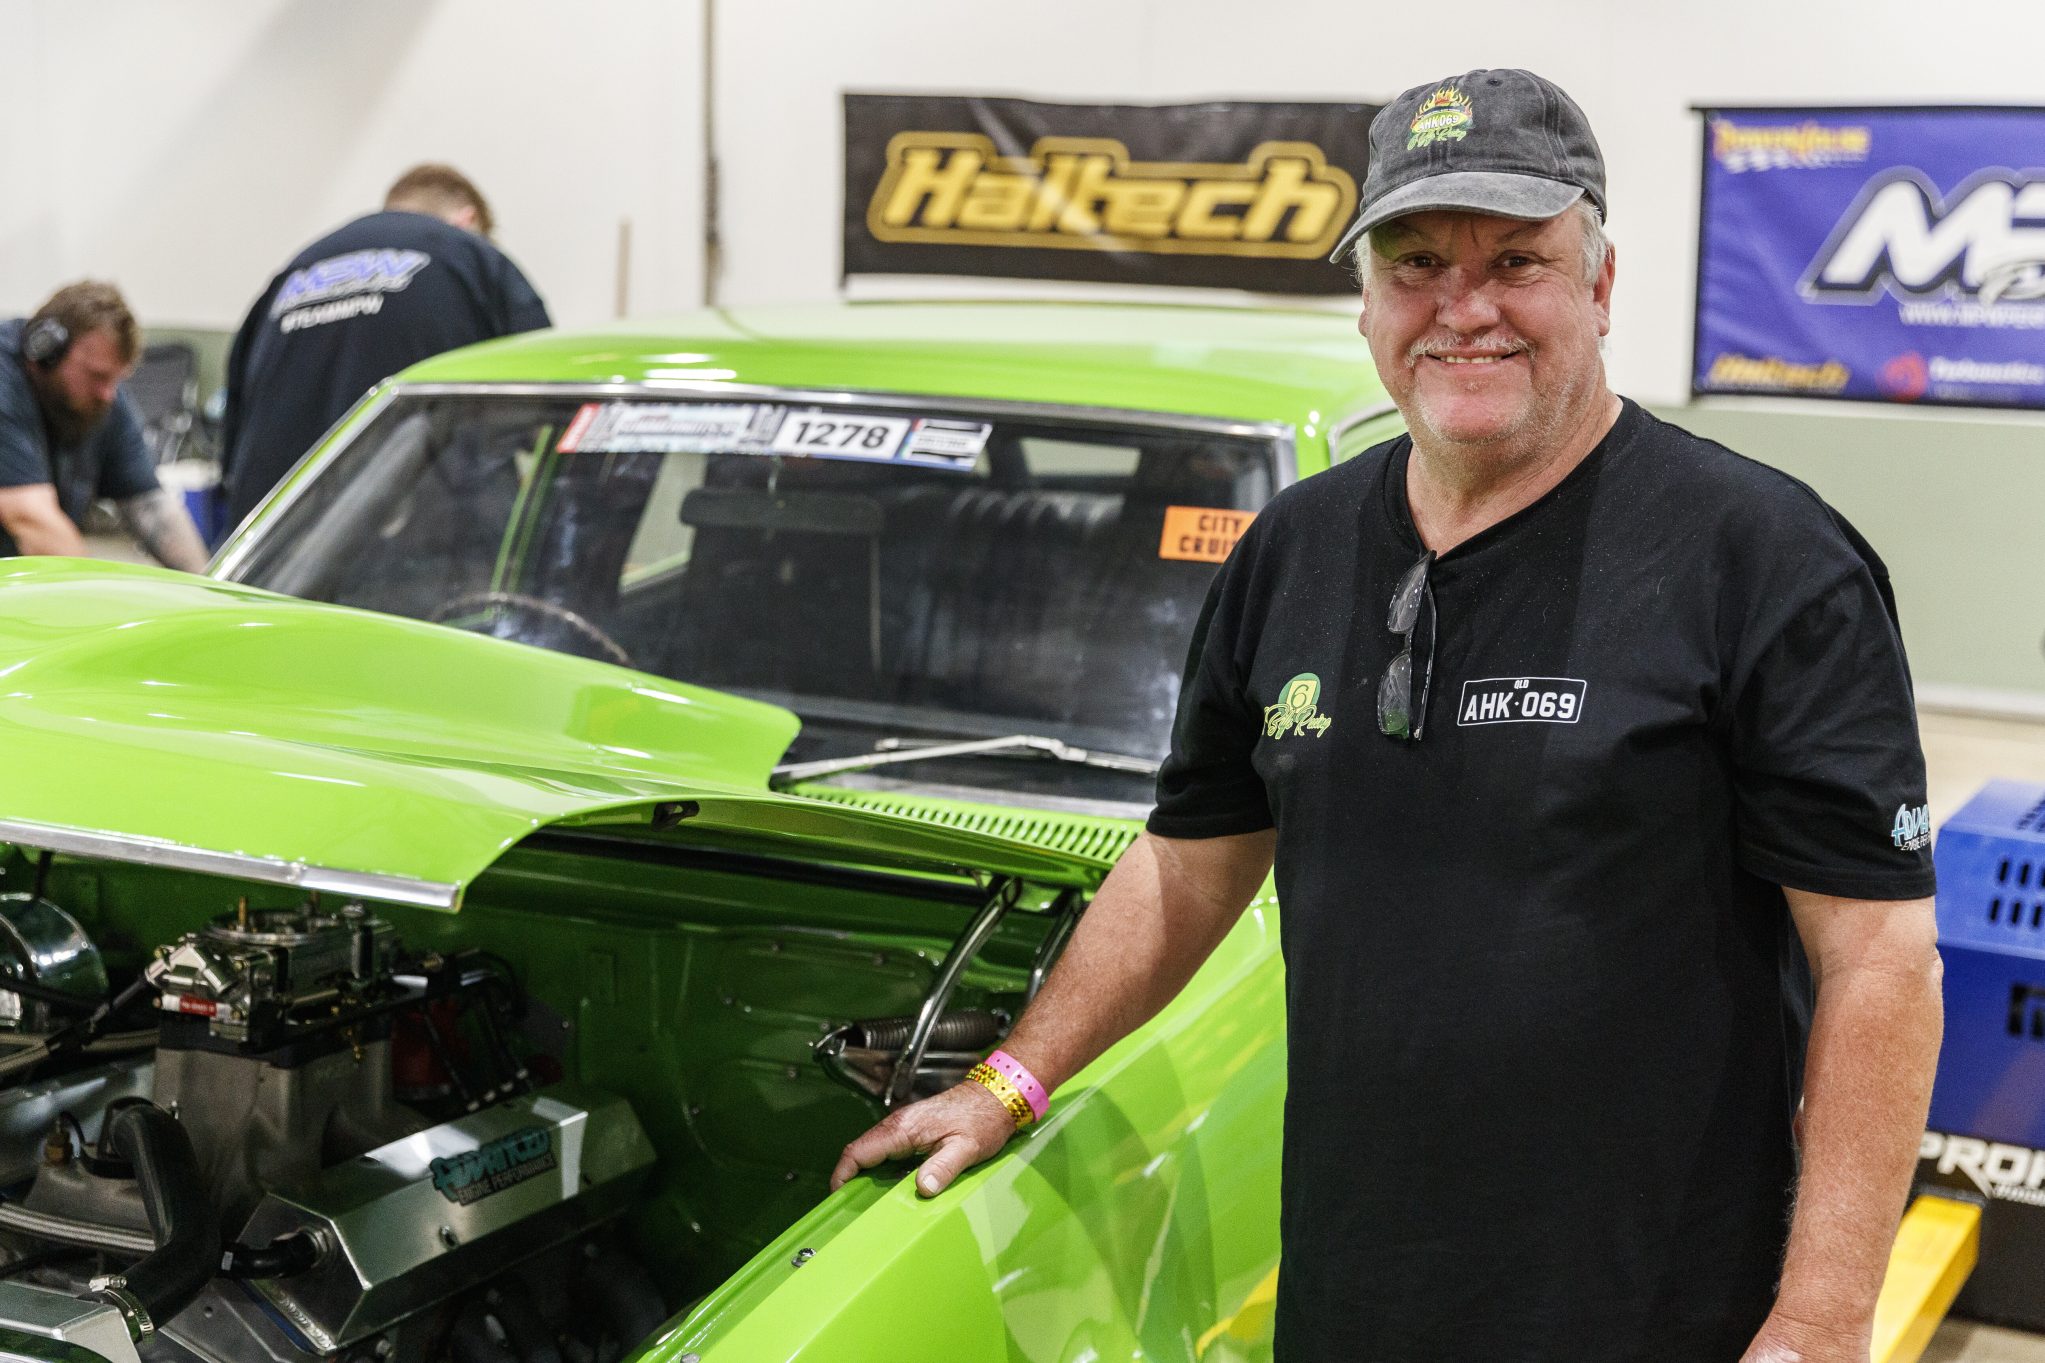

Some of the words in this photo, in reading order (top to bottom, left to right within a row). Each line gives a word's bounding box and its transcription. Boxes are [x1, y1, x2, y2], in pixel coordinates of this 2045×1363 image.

[880, 147, 1342, 244] Haltech
[794, 421, 890, 449] 1278
[1199, 515, 1244, 534] CITY
[1179, 535, 1238, 556] CRUI
[1514, 679, 1530, 689] QLD
[1291, 684, 1309, 709] 6
